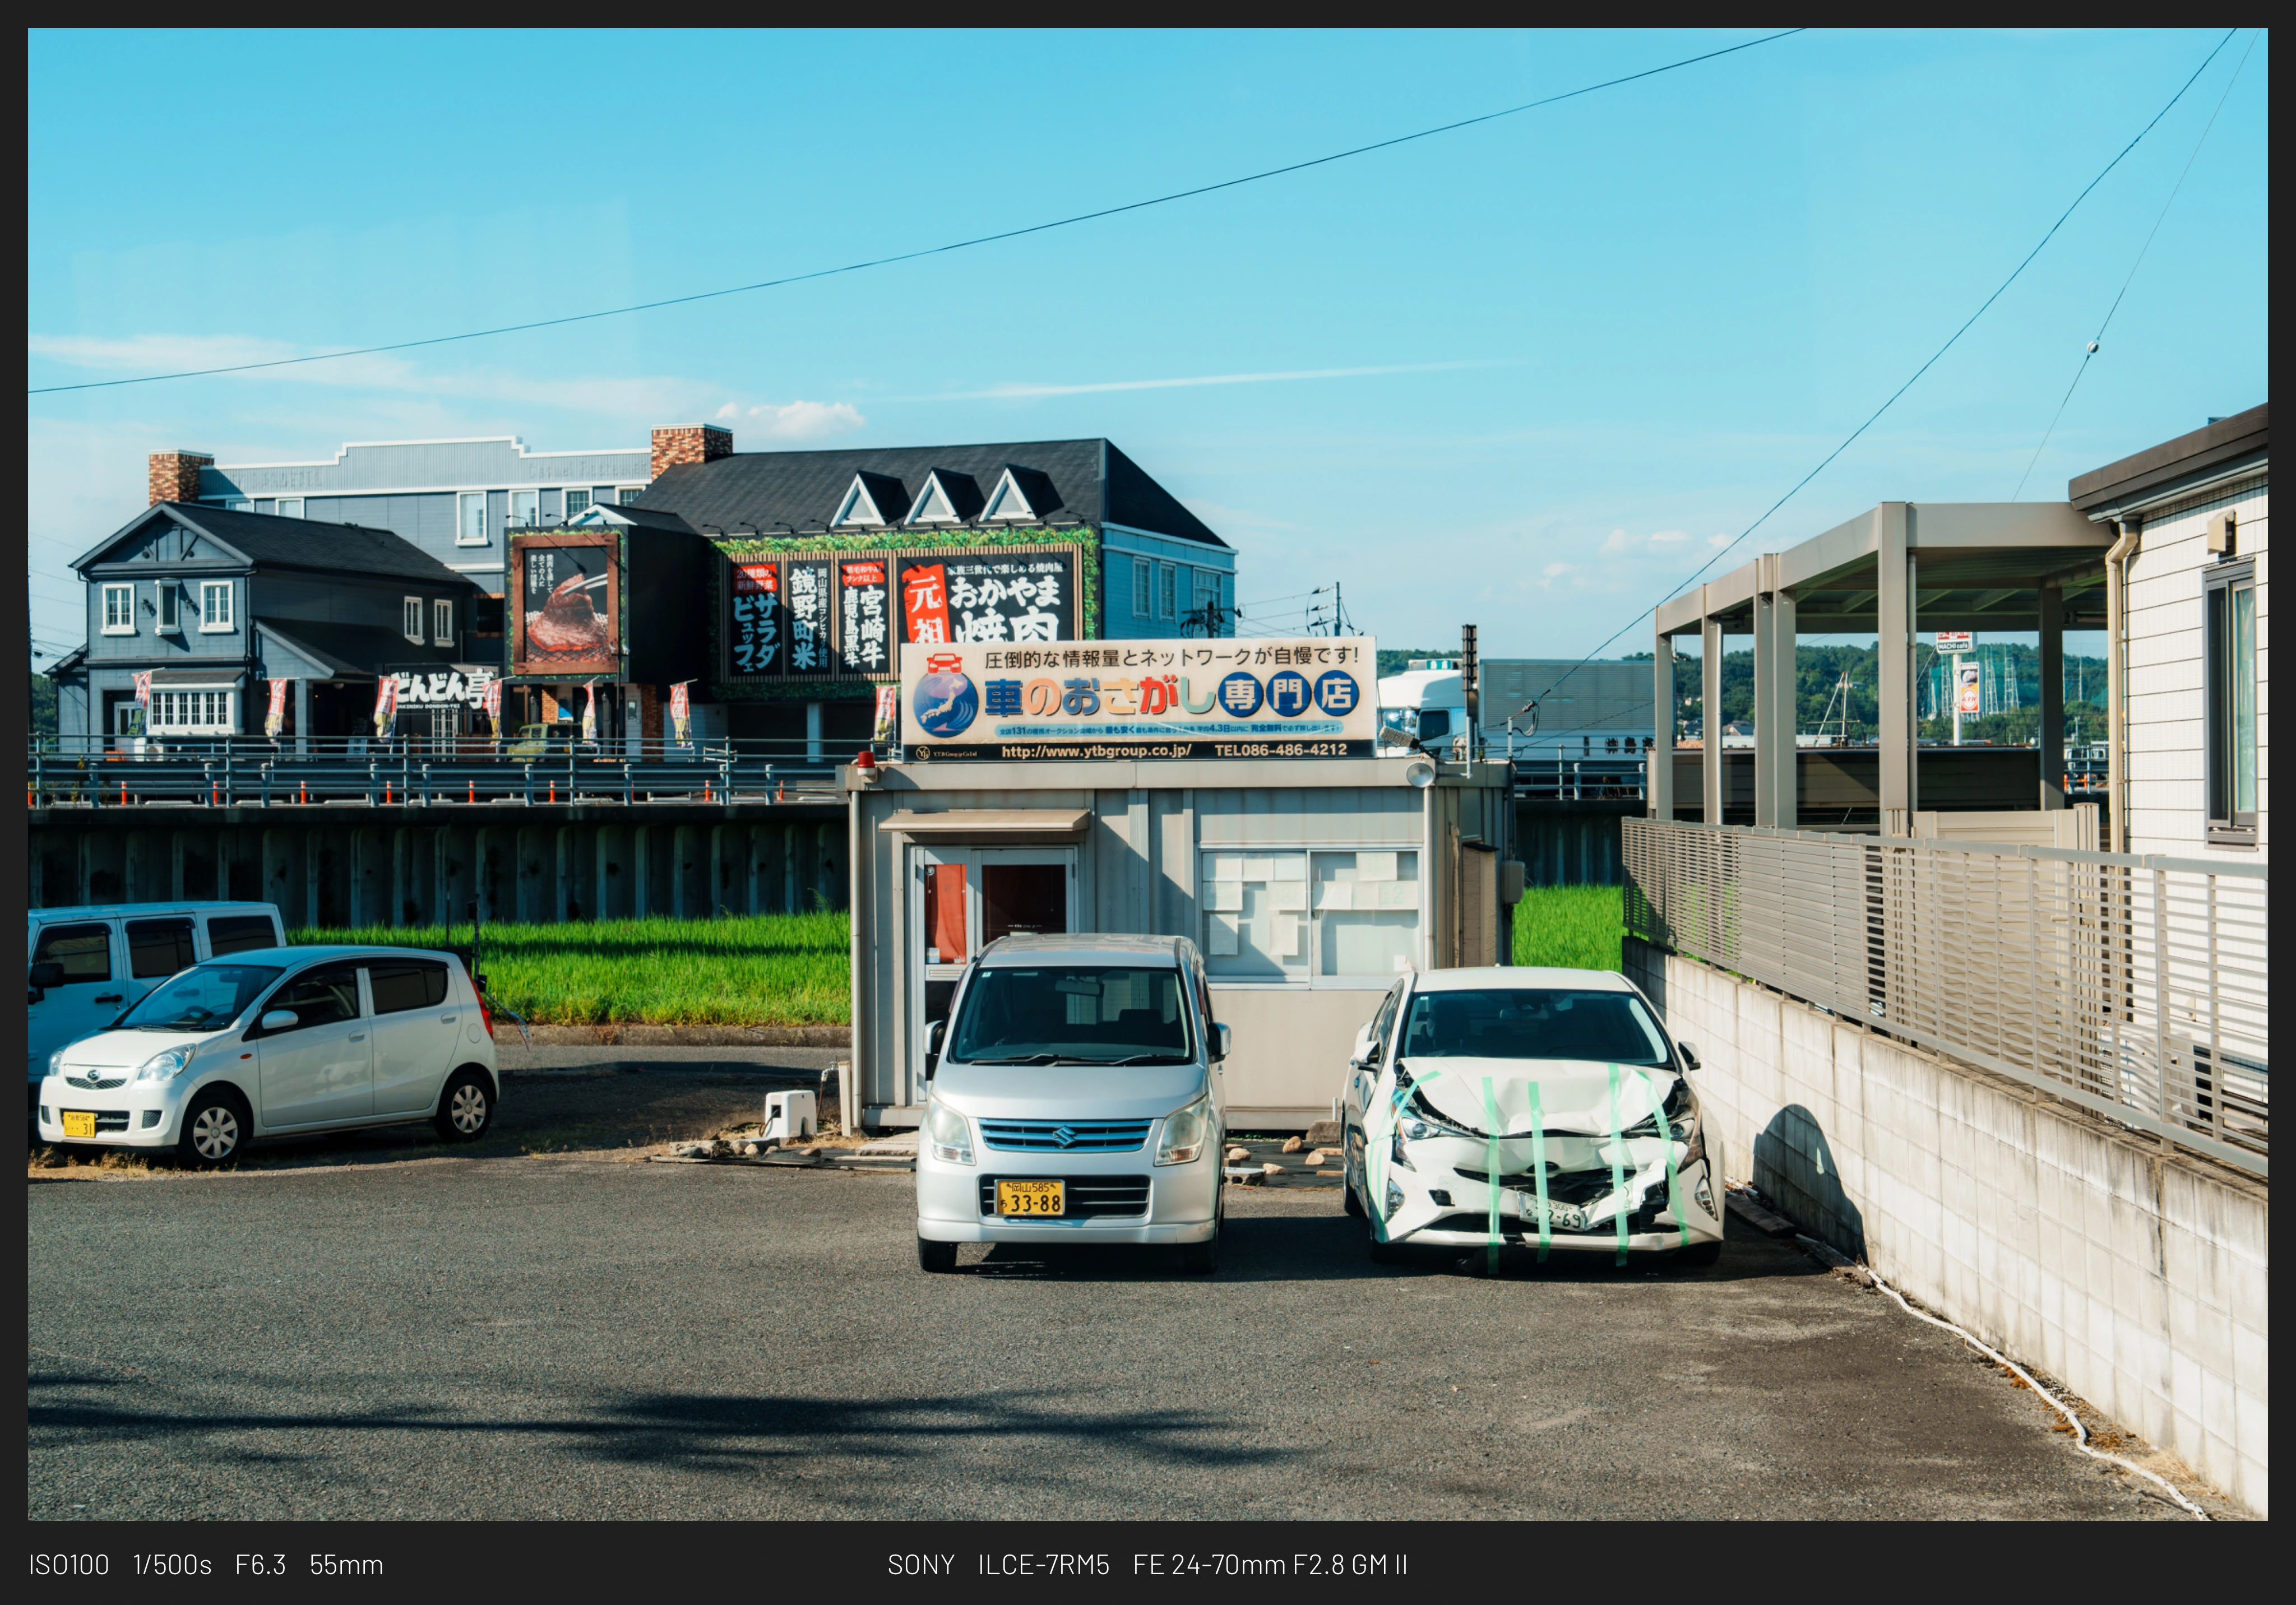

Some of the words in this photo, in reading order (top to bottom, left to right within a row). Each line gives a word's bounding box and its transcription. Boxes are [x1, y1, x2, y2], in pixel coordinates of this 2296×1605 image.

[737, 567, 773, 579] 20種類の
[737, 579, 774, 591] 新鮮野菜
[846, 574, 878, 583] ランク以上
[947, 562, 1063, 576] 家族三世代で楽しめる焼肉屋
[909, 575, 945, 643] 元祖
[949, 574, 1061, 609] おかやま
[733, 595, 754, 672] ビュッフェ
[754, 592, 781, 669] サラダ
[789, 565, 818, 670] 鏡野町米
[817, 568, 828, 668] 岡山県産コシヒカリ使用
[843, 586, 860, 669] 鹿児島黒牛
[859, 585, 886, 670] 宮崎牛
[955, 605, 1059, 642] 焼肉
[985, 646, 1359, 669] 圧倒的な情報量とネットワークが自慢です!
[391, 667, 494, 709] どんどん亭
[1002, 744, 1192, 759] http://www.ytbgroup.co.jp/
[1215, 743, 1347, 757] TEL086-486-4212
[1011, 1194, 1061, 1212] 33-88
